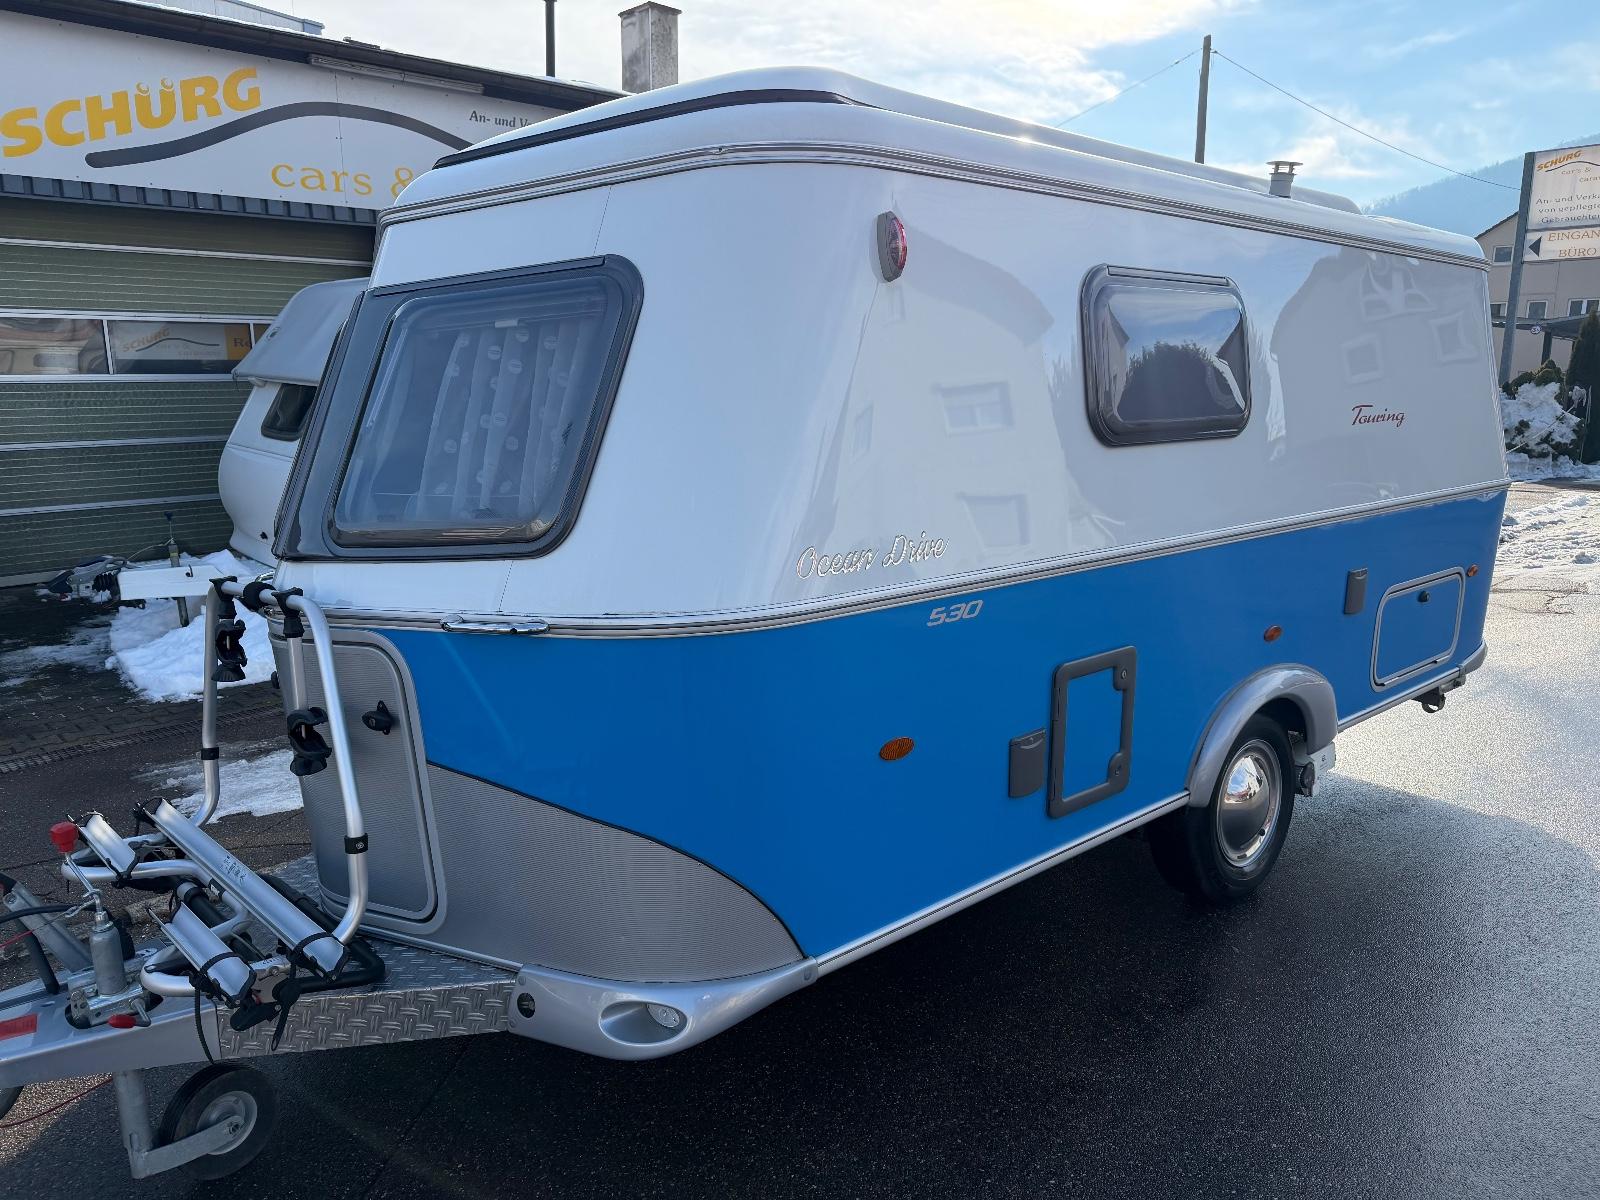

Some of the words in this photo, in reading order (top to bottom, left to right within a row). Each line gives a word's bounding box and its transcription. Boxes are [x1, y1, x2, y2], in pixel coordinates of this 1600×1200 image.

[0, 67, 261, 158] SCHÜRG
[469, 110, 491, 124] An-
[494, 116, 516, 128] und
[271, 163, 372, 196] cars
[1559, 246, 1597, 257] BÜRO
[1351, 404, 1405, 428] Touring
[796, 546, 879, 579] Ocean
[882, 531, 950, 567] Drive
[926, 599, 983, 627] 530
